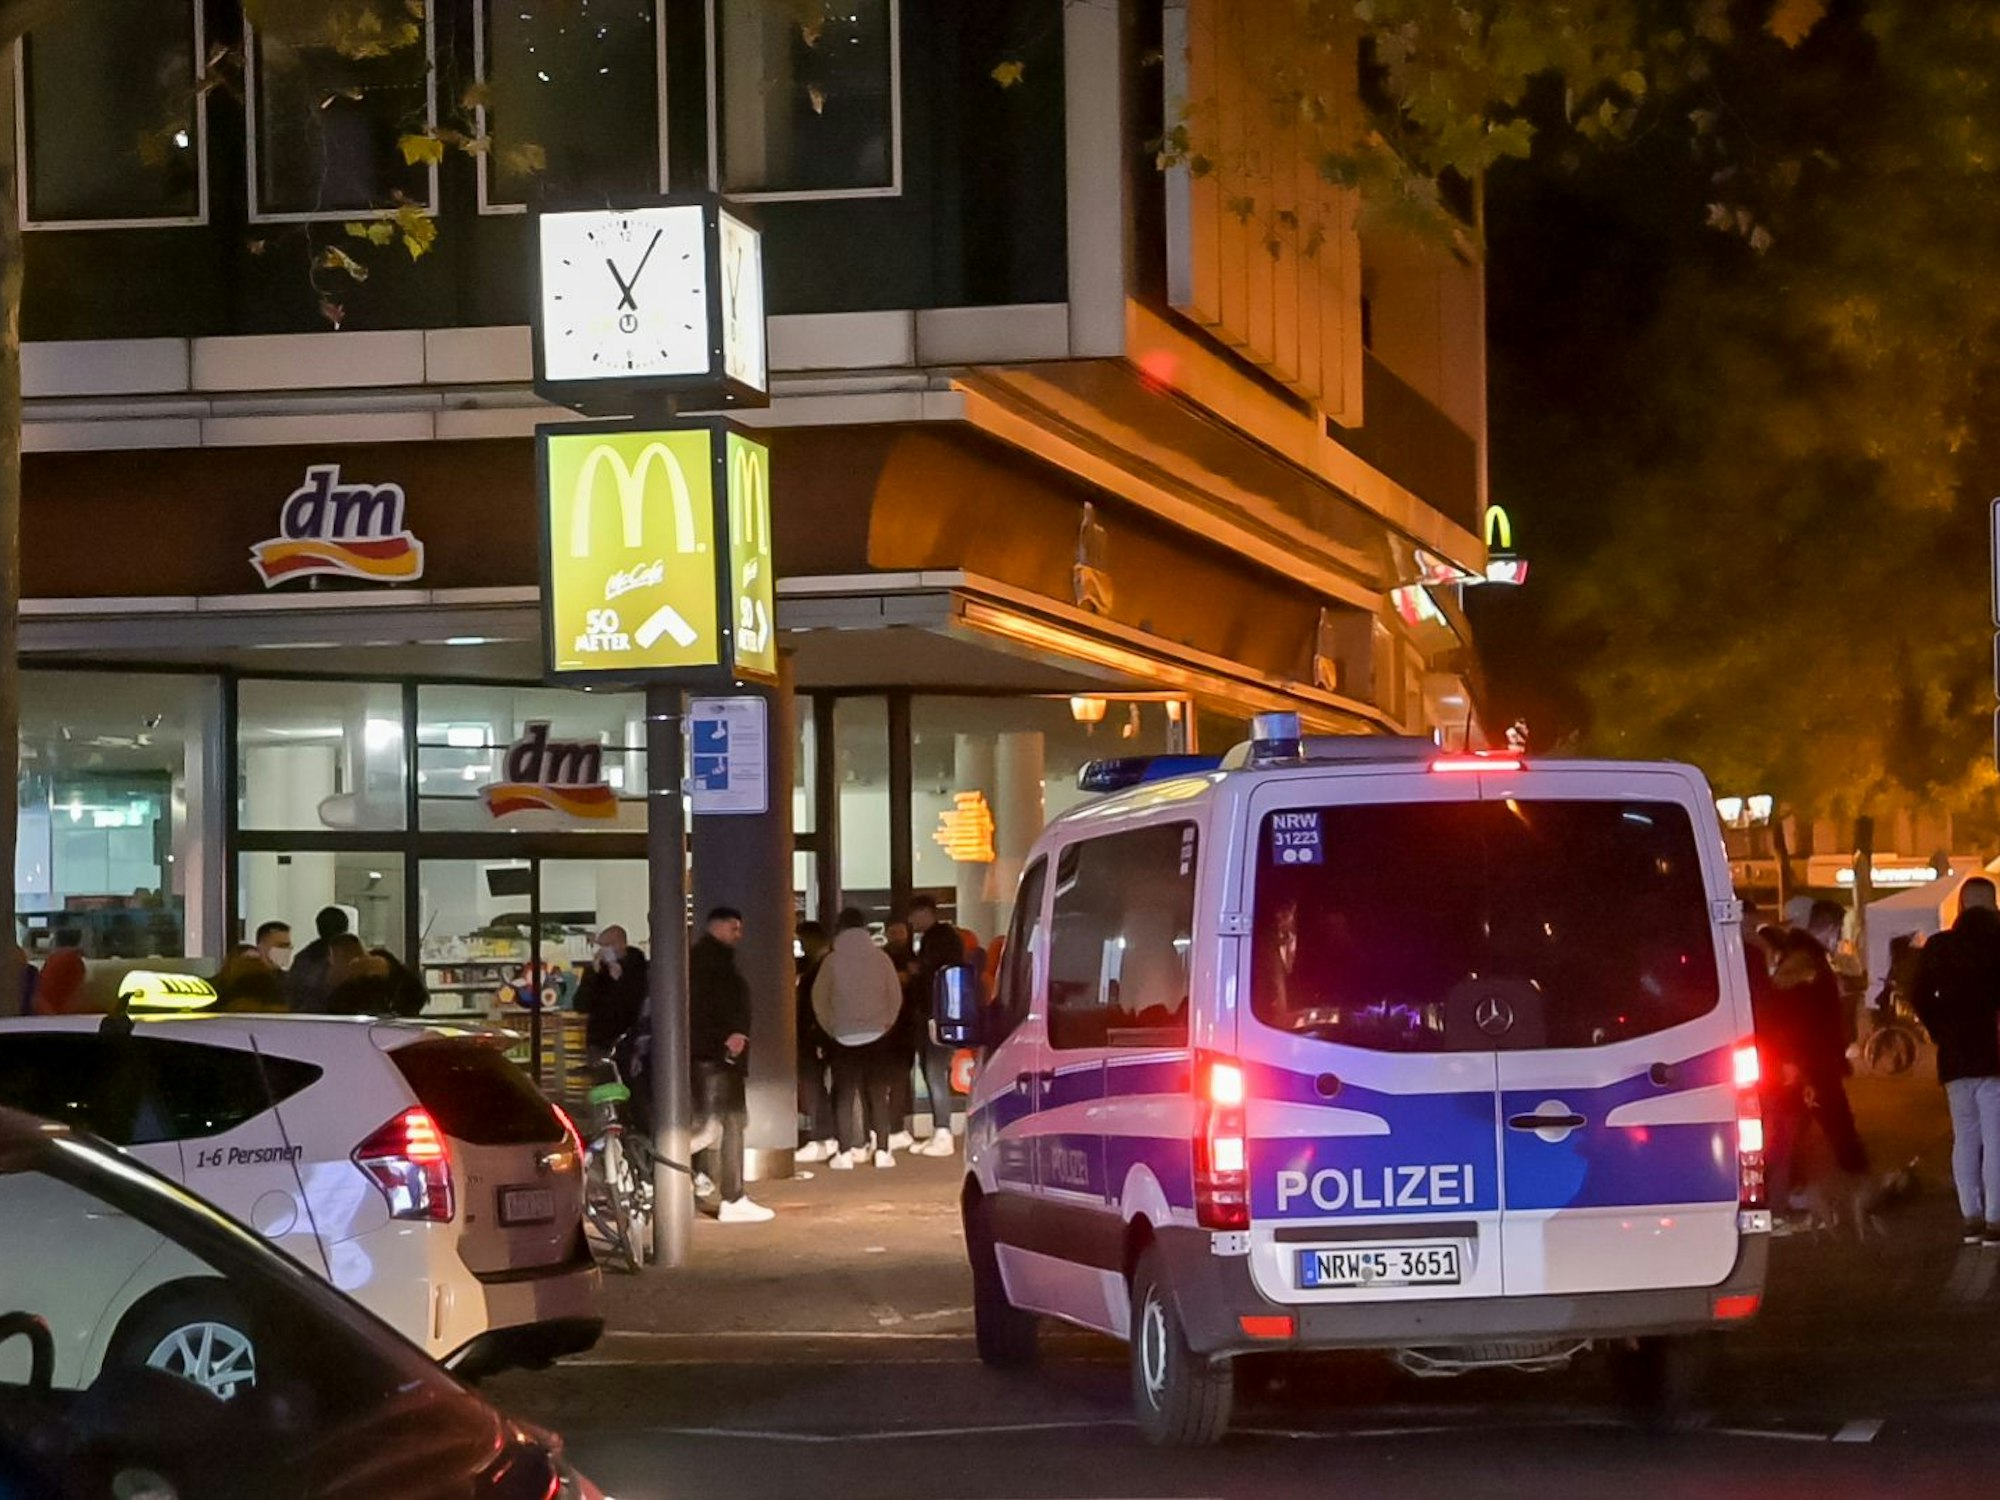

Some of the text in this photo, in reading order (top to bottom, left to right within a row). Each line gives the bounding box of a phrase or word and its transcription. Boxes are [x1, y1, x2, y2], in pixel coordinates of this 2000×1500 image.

[285, 470, 398, 539] dm
[585, 608, 620, 634] 50
[508, 724, 601, 784] dm
[1273, 812, 1318, 829] NRW
[1274, 831, 1319, 846] 31223
[197, 1146, 303, 1168] 1-6 Personen
[1276, 1164, 1475, 1212] POLIZEI
[1317, 1253, 1360, 1279] NRW
